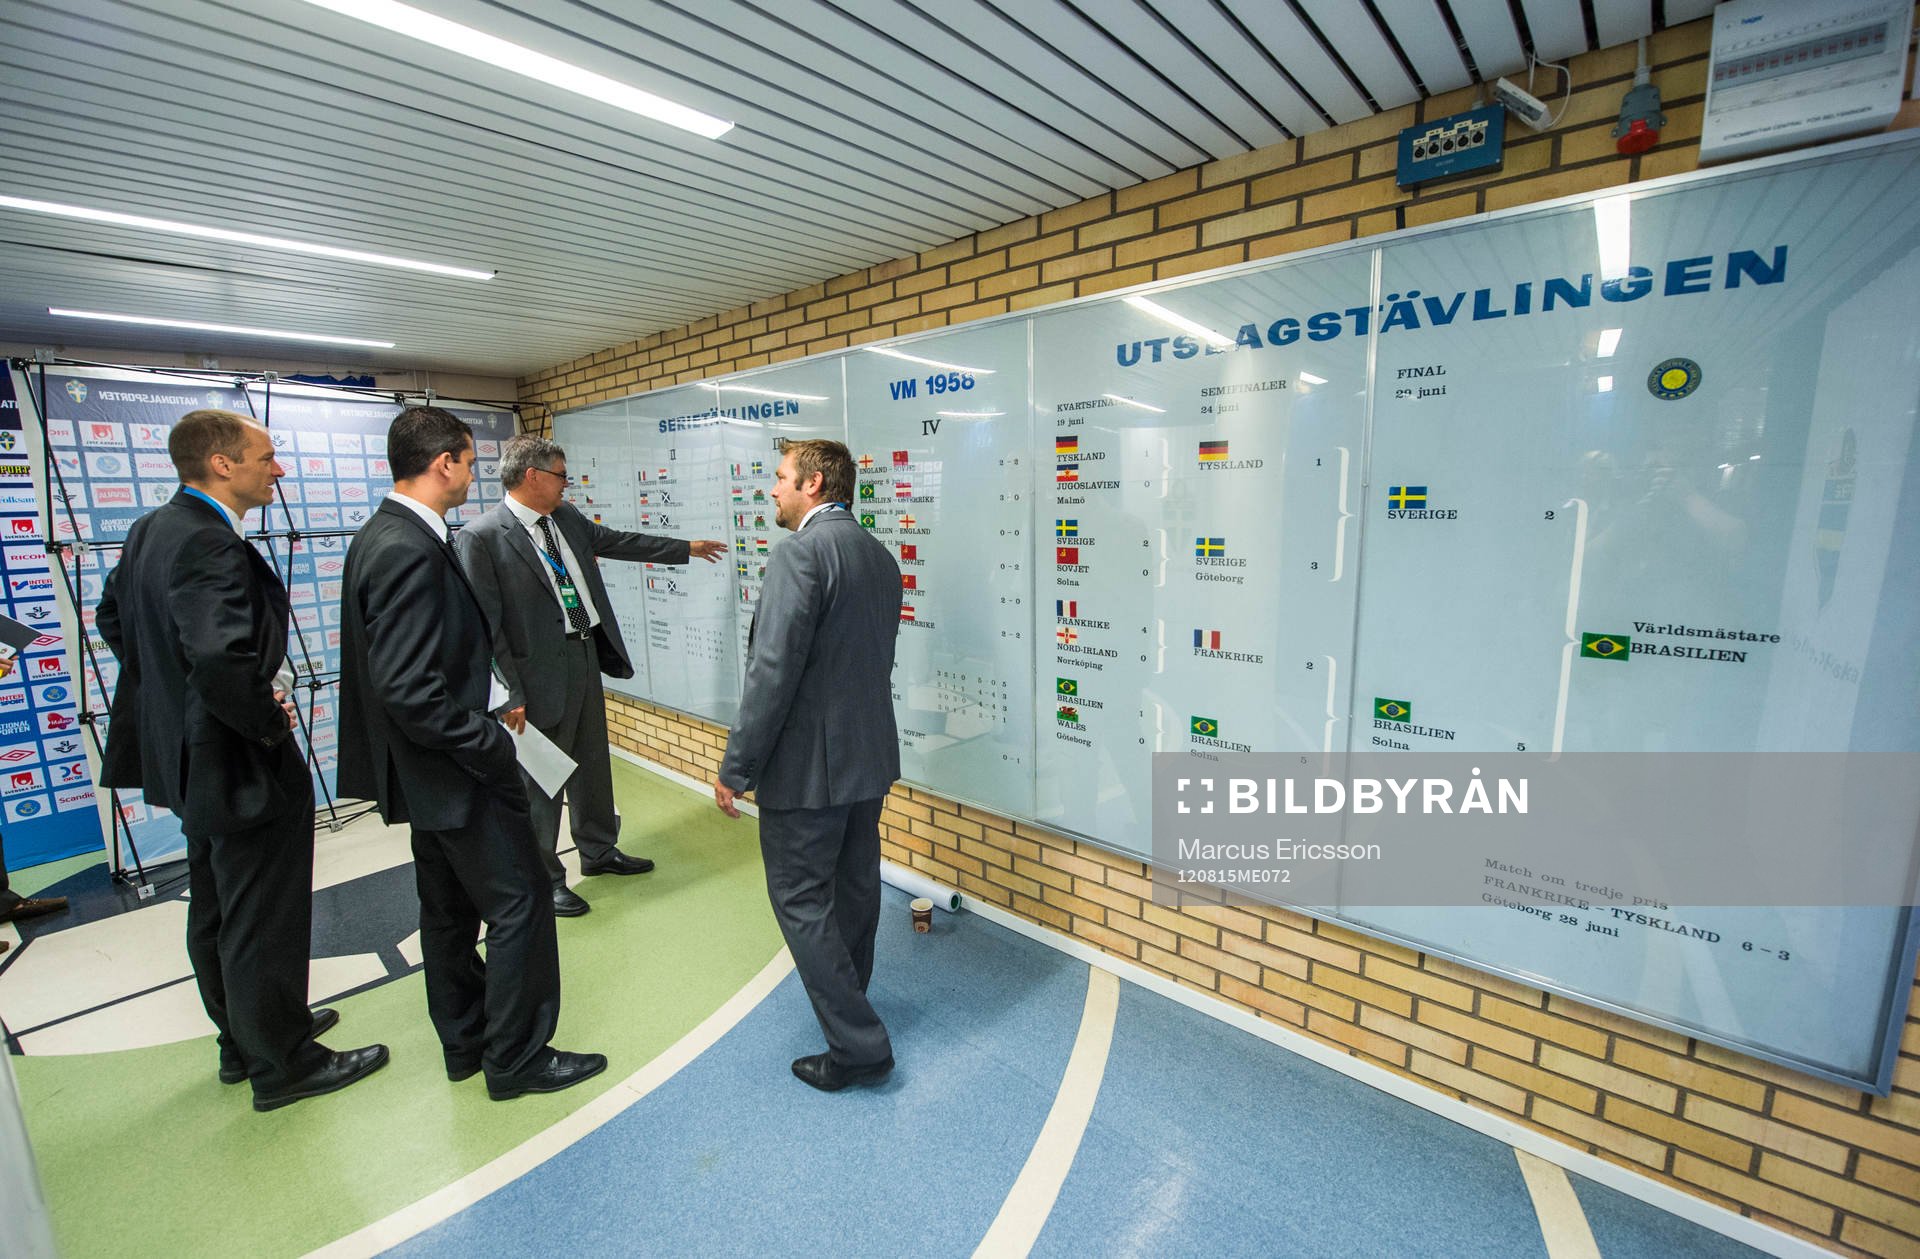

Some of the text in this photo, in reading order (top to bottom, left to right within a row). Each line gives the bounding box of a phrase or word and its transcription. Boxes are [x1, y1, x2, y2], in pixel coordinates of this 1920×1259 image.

[1397, 364, 1447, 380] FINAL
[890, 372, 975, 400] VM 1958
[1200, 380, 1287, 397] SEMIFINALER
[1417, 385, 1447, 400] juni
[1057, 396, 1134, 412] KVARTSFINA
[1200, 403, 1240, 414] 24 juni
[922, 419, 941, 436] IV
[1057, 417, 1084, 428] 19 juni
[1056, 452, 1106, 463] TYSKLAND
[1316, 458, 1322, 466] 1
[1198, 459, 1263, 470] TYSKLAND
[1056, 481, 1120, 491] JUGOSLAVIEN
[1144, 480, 1150, 488] 0
[1057, 496, 1085, 505] Malmö
[1388, 509, 1458, 520] SVERIGE
[1544, 510, 1555, 520] 2
[867, 527, 931, 535] ASILIEN ENGLAND
[1056, 537, 1095, 546] SVERIGE
[1143, 539, 1149, 547] 2
[1196, 557, 1247, 568] SVERIGE
[1311, 562, 1318, 570] 3
[1057, 565, 1090, 574] SOVJET
[1057, 577, 1080, 587] Solna
[1195, 571, 1244, 585] Göteborg
[1057, 616, 1110, 630] FRANKRIKE
[1141, 626, 1147, 634] 4
[1633, 622, 1781, 644] Världsmästare
[1057, 643, 1118, 658] NORD-IRLAND
[1193, 648, 1263, 664] FRANKRIKE
[1630, 642, 1748, 663] BRASILIEN
[1057, 656, 1103, 671] Norrköping
[1140, 654, 1147, 662] 0
[1306, 662, 1313, 670] 2
[1057, 694, 1103, 710] BRASILIEN
[1139, 710, 1144, 718] 1
[1057, 720, 1087, 732] WALES
[1373, 719, 1456, 741] BRASILIEN
[1056, 732, 1092, 748] Göteborg
[1138, 737, 1145, 745] 0
[1191, 735, 1251, 753] BRASILIEN
[1372, 736, 1410, 751] Solna
[1517, 742, 1526, 752] 5
[1190, 749, 1219, 762] Solna
[1300, 756, 1307, 765] 5
[59, 792, 95, 804] Scandic
[1484, 858, 1669, 912] Match om tredje pris
[1481, 892, 1620, 939] Göteborg 28 juni
[1484, 875, 1590, 911] FRANKRIKE
[1611, 907, 1721, 944] TYSKLAND
[1742, 941, 1753, 952] 6
[1778, 950, 1790, 962] 3
